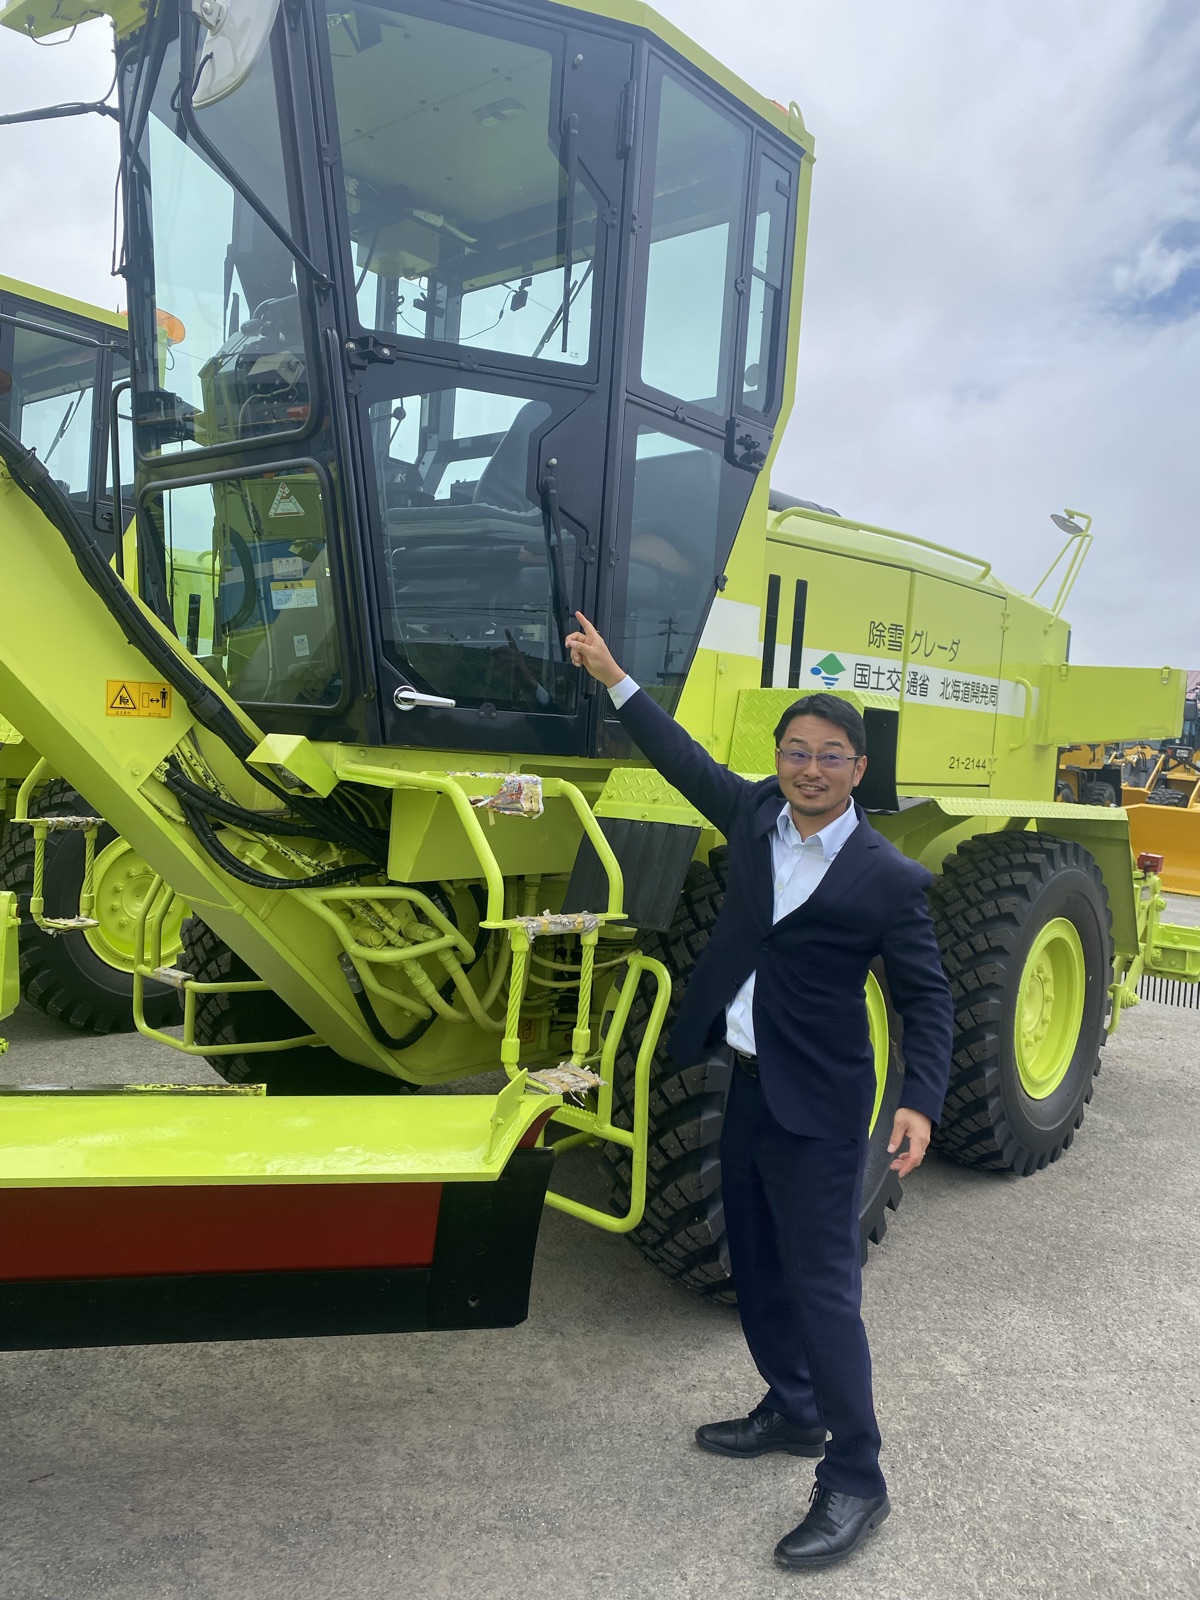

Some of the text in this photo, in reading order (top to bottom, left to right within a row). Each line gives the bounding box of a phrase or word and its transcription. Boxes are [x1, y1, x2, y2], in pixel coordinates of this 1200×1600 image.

[853, 662, 999, 707] 国土交通省 北海道開発局
[948, 756, 987, 771] 21-2144
